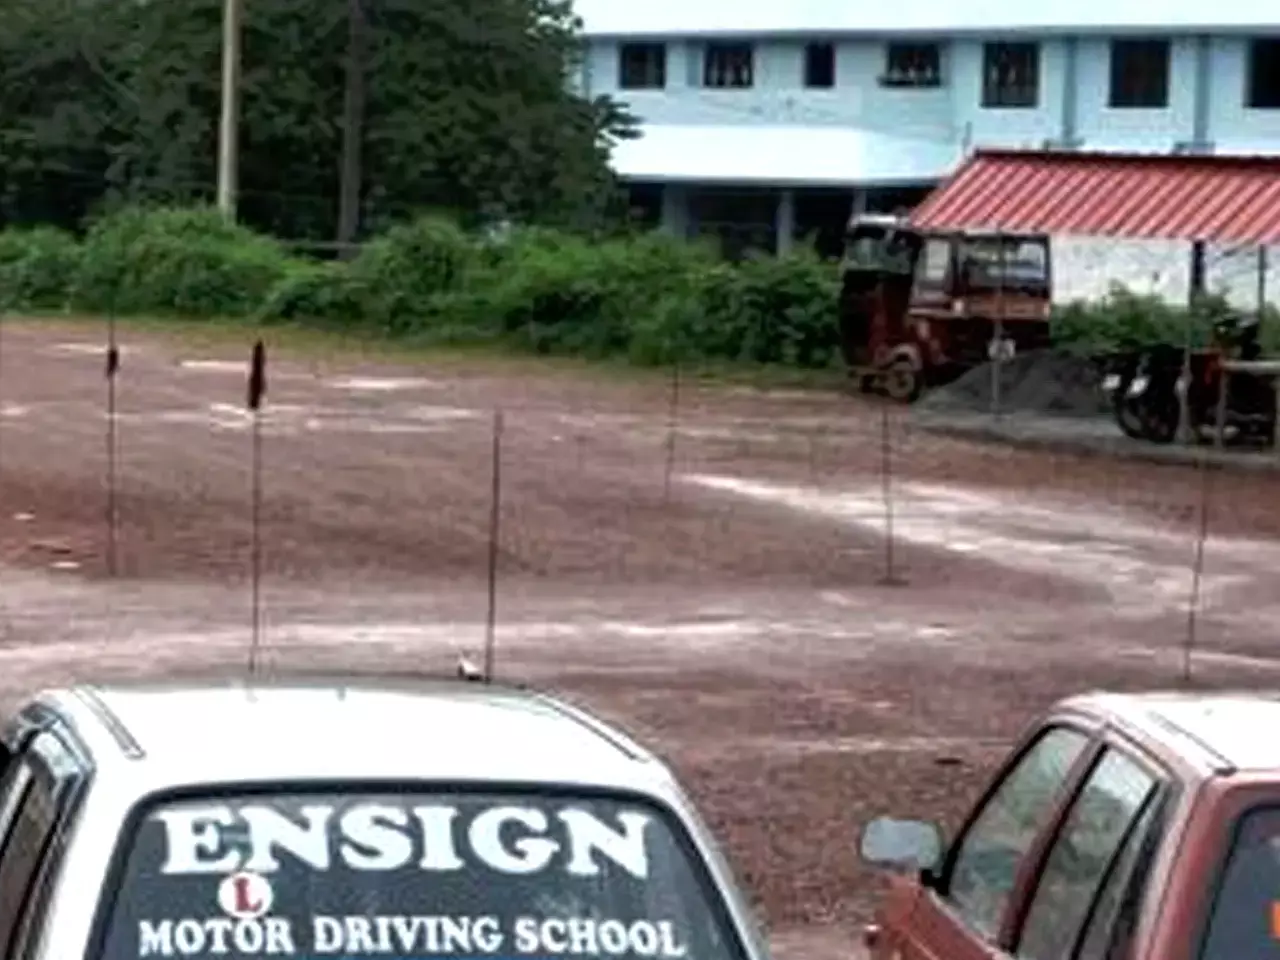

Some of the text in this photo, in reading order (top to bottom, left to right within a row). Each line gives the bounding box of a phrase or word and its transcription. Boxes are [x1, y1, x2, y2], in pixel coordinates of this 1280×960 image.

[157, 805, 652, 878] ENSIGN
[232, 877, 262, 912] L
[138, 915, 686, 957] MOTOR DRIVING SCHOOL
